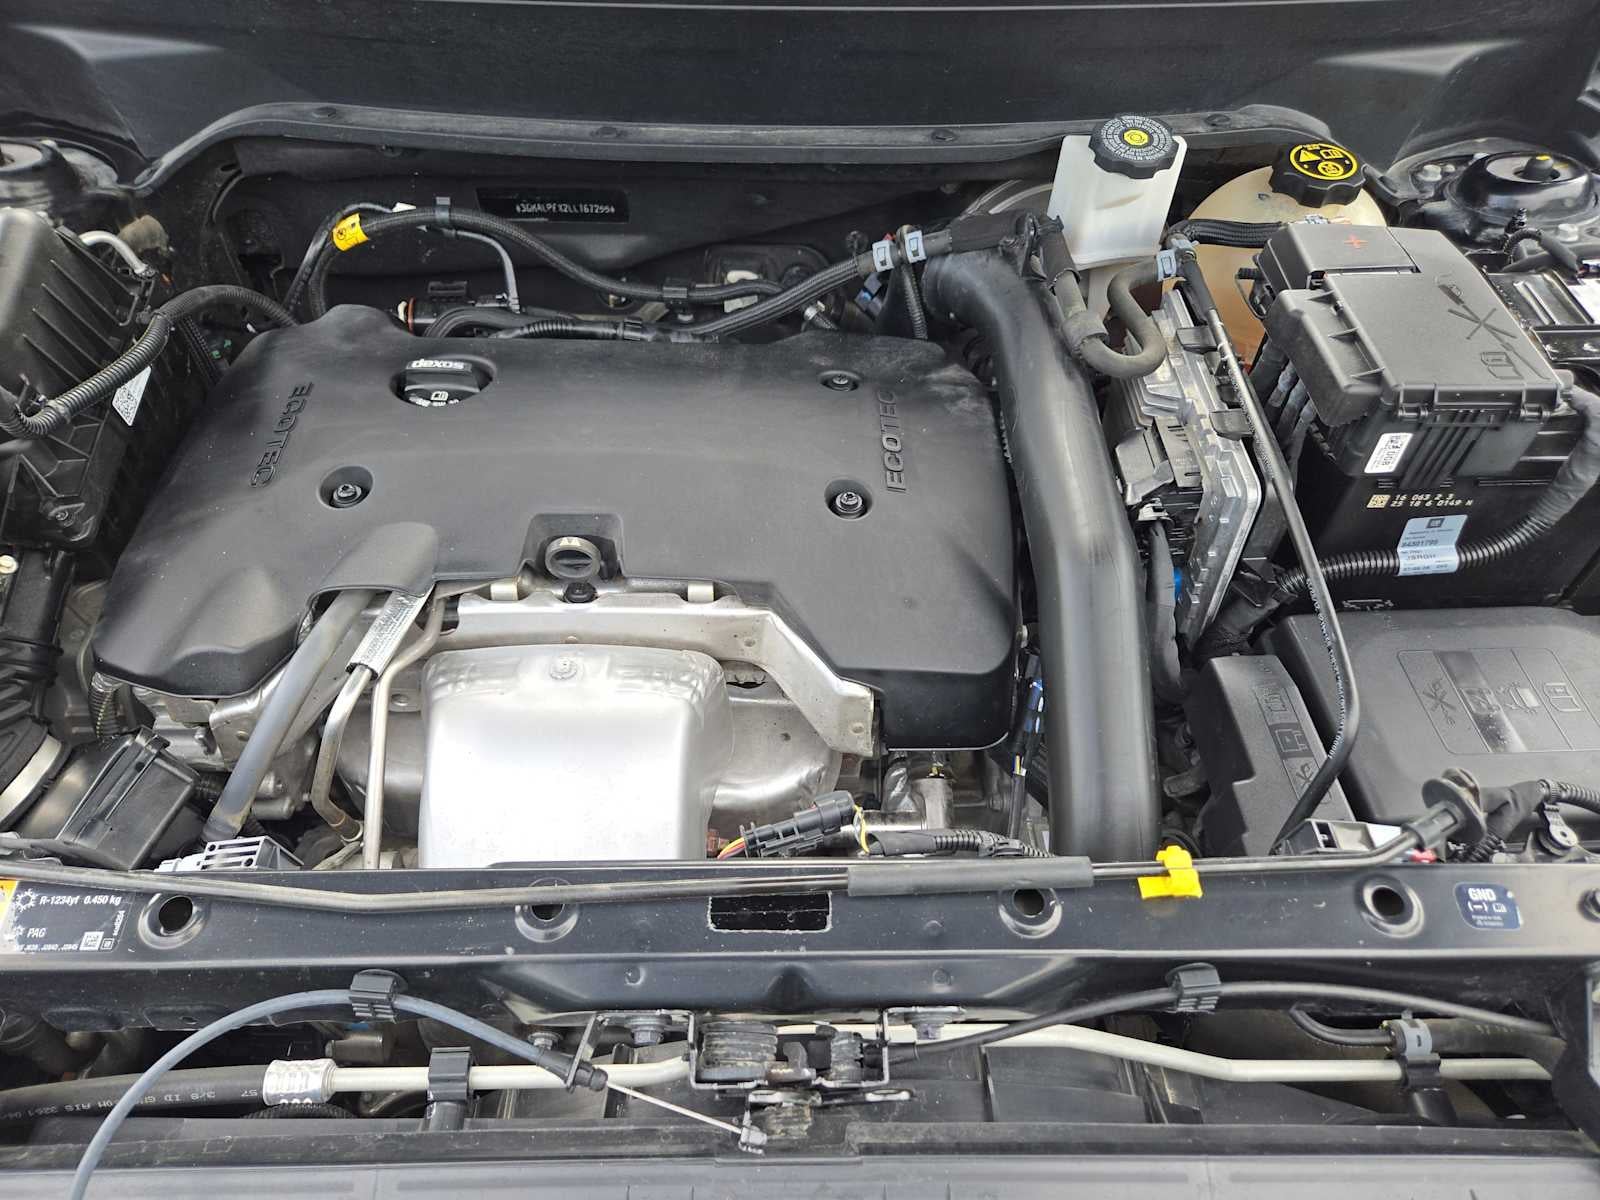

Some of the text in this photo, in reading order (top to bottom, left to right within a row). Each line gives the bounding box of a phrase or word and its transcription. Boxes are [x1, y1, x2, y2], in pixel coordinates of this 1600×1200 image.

[411, 358, 465, 370] dexos
[250, 382, 315, 488] ECOTEC
[877, 389, 906, 492] ECOTEC
[39, 895, 122, 906] R-1234yf 0.450 kg
[1468, 888, 1497, 901] GND
[27, 927, 47, 938] PAG
